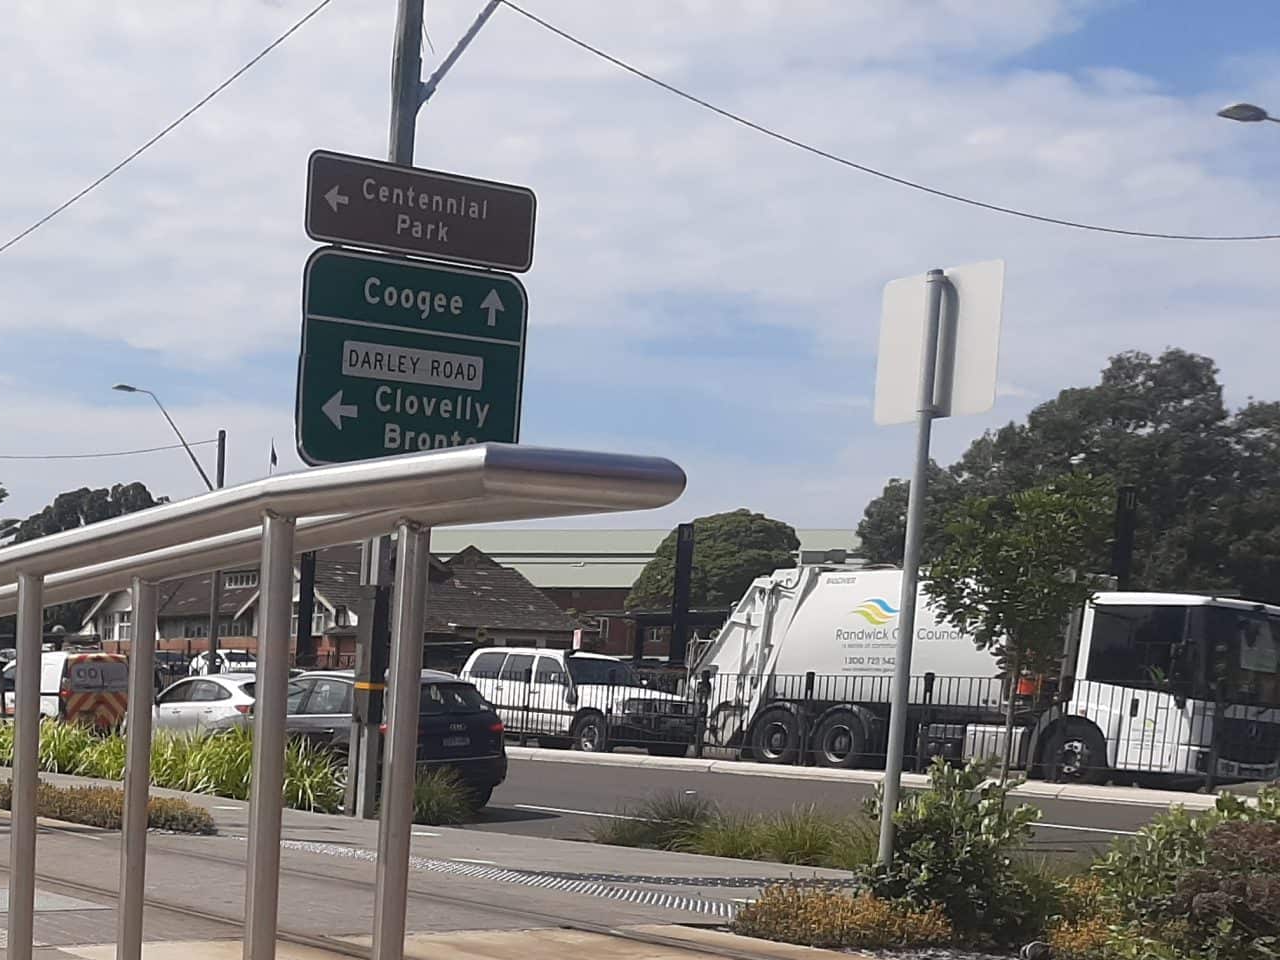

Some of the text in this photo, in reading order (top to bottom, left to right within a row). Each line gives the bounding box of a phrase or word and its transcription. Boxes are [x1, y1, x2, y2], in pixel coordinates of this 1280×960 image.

[363, 178, 488, 219] Centennial
[396, 214, 449, 242] Park
[363, 276, 464, 319] Coogee
[348, 349, 478, 382] DARLEY ROAD
[375, 385, 490, 427] Clovelly
[835, 628, 889, 640] Randwick
